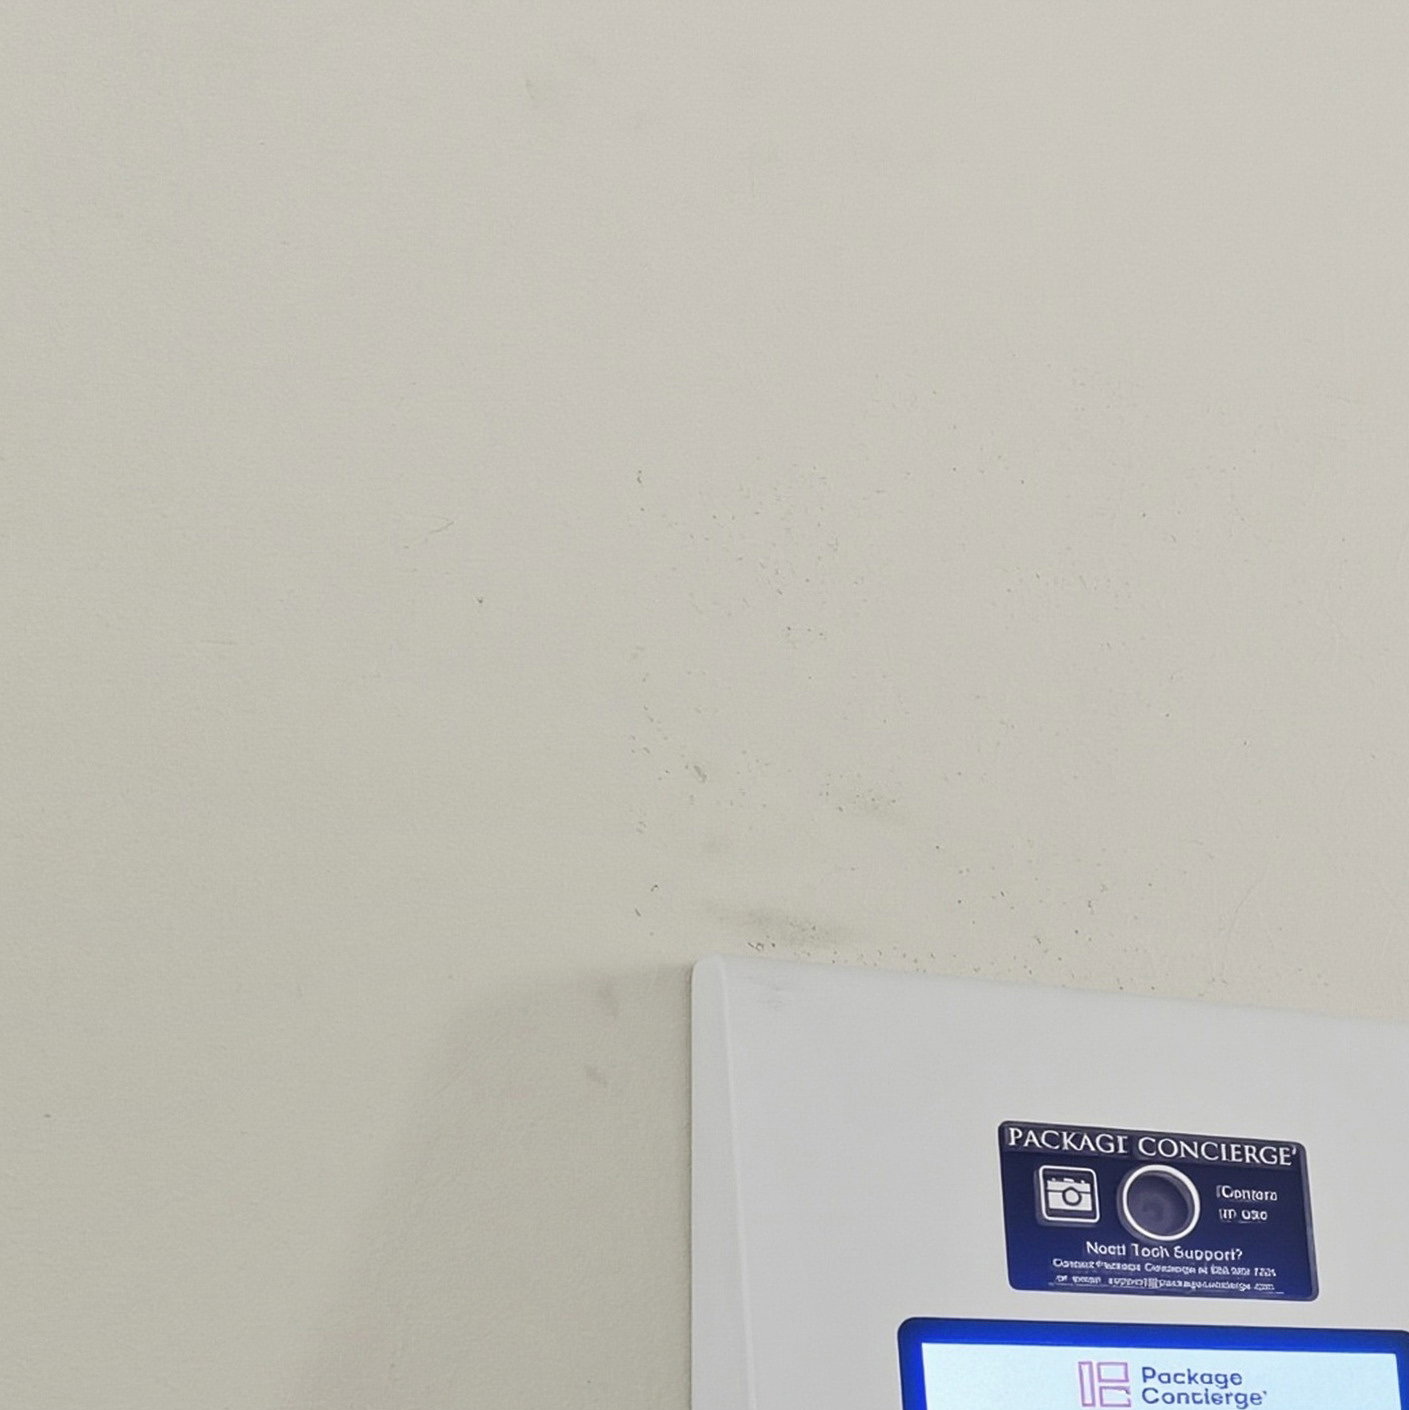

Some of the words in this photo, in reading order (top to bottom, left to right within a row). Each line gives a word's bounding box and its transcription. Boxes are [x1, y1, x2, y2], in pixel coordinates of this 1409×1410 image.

[1008, 1127, 1129, 1154] PACKAGE
[1173, 1245, 1243, 1261] Support?
[1142, 1366, 1242, 1389] Package
